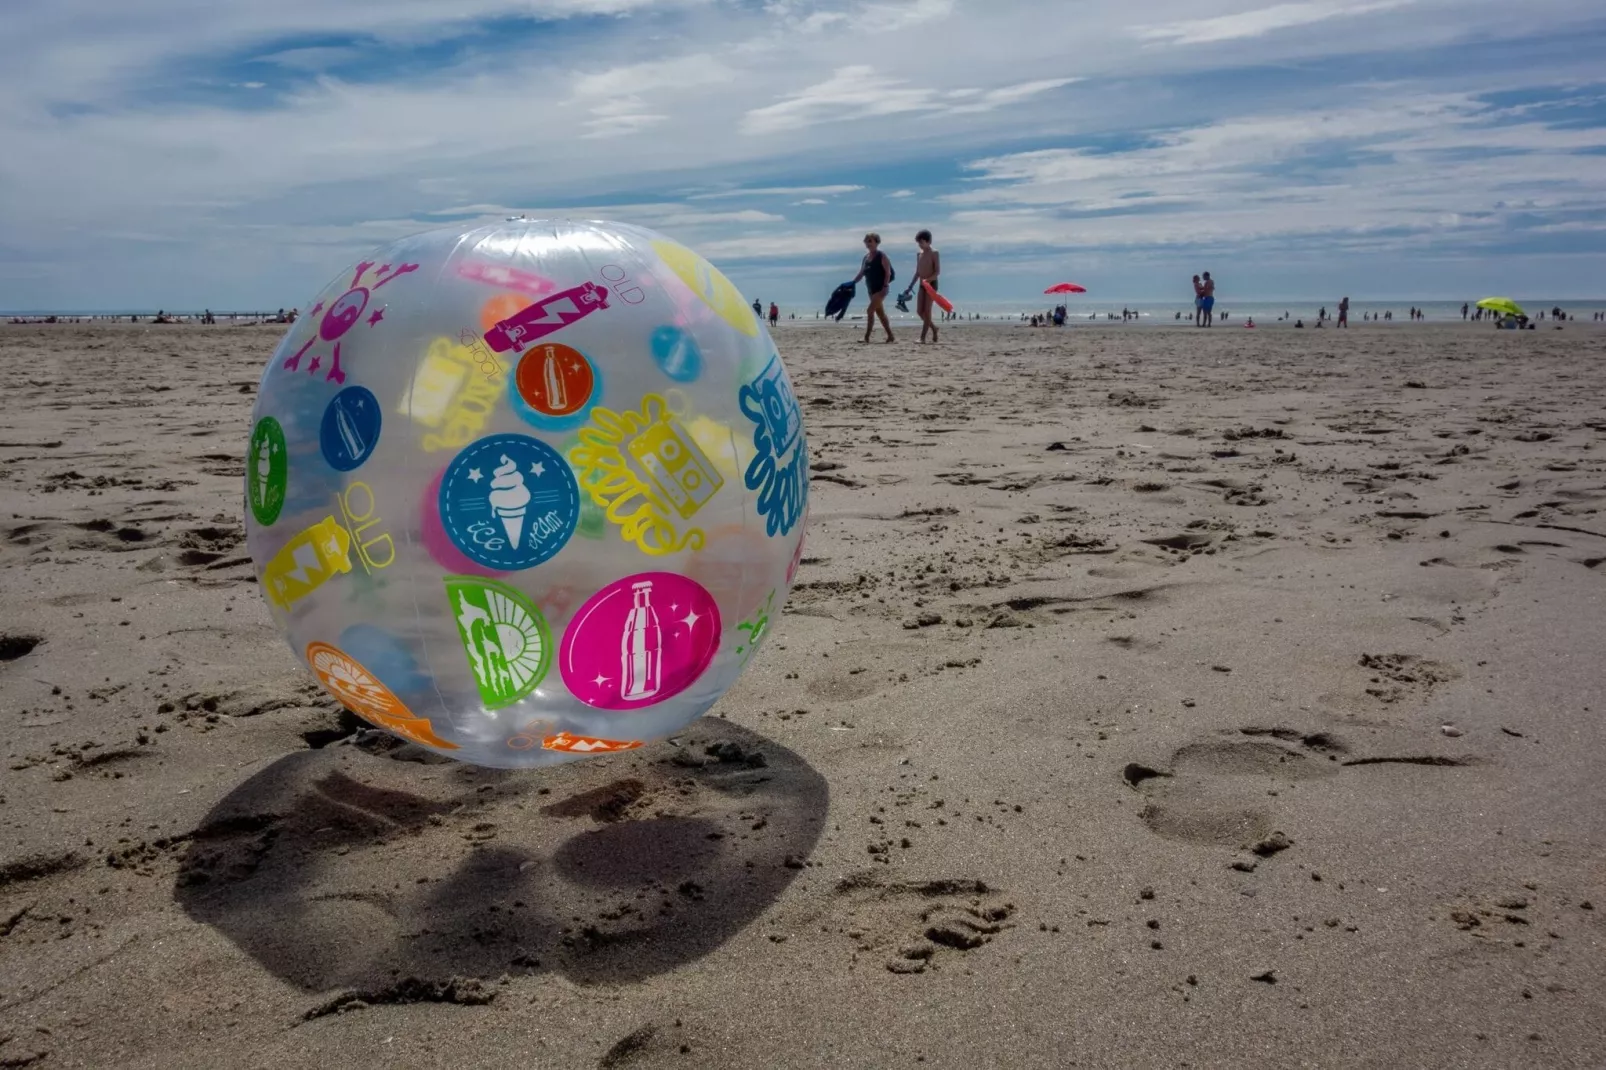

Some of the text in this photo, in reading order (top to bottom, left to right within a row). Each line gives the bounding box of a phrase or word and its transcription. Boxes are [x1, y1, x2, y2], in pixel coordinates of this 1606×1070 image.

[600, 264, 646, 305] OLD
[456, 326, 499, 380] SCHOOL
[344, 481, 396, 569] OLD
[528, 509, 564, 550] cream
